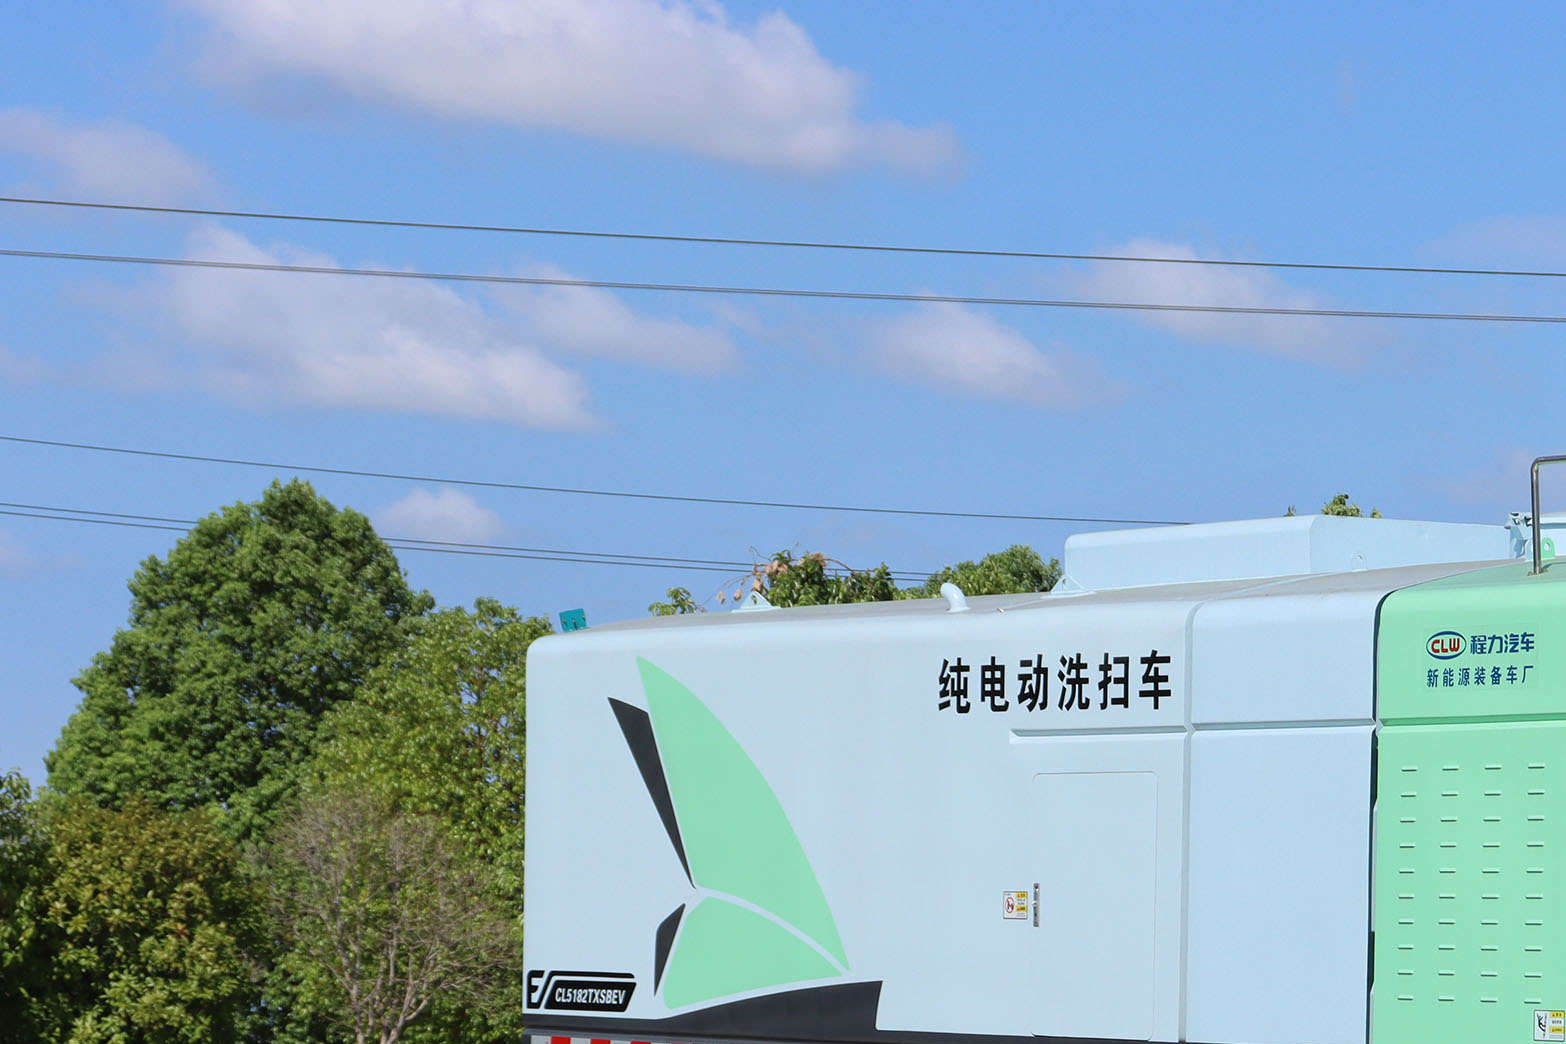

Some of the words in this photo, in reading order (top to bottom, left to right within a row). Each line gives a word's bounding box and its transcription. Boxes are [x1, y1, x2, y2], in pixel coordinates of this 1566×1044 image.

[1431, 637, 1460, 653] CLW
[1470, 631, 1535, 655] 程力汽车
[938, 649, 1171, 713] 纯电动洗扫车
[1426, 664, 1534, 688] 新能源装备车厂
[555, 987, 626, 1005] CL5182TXSBEV
